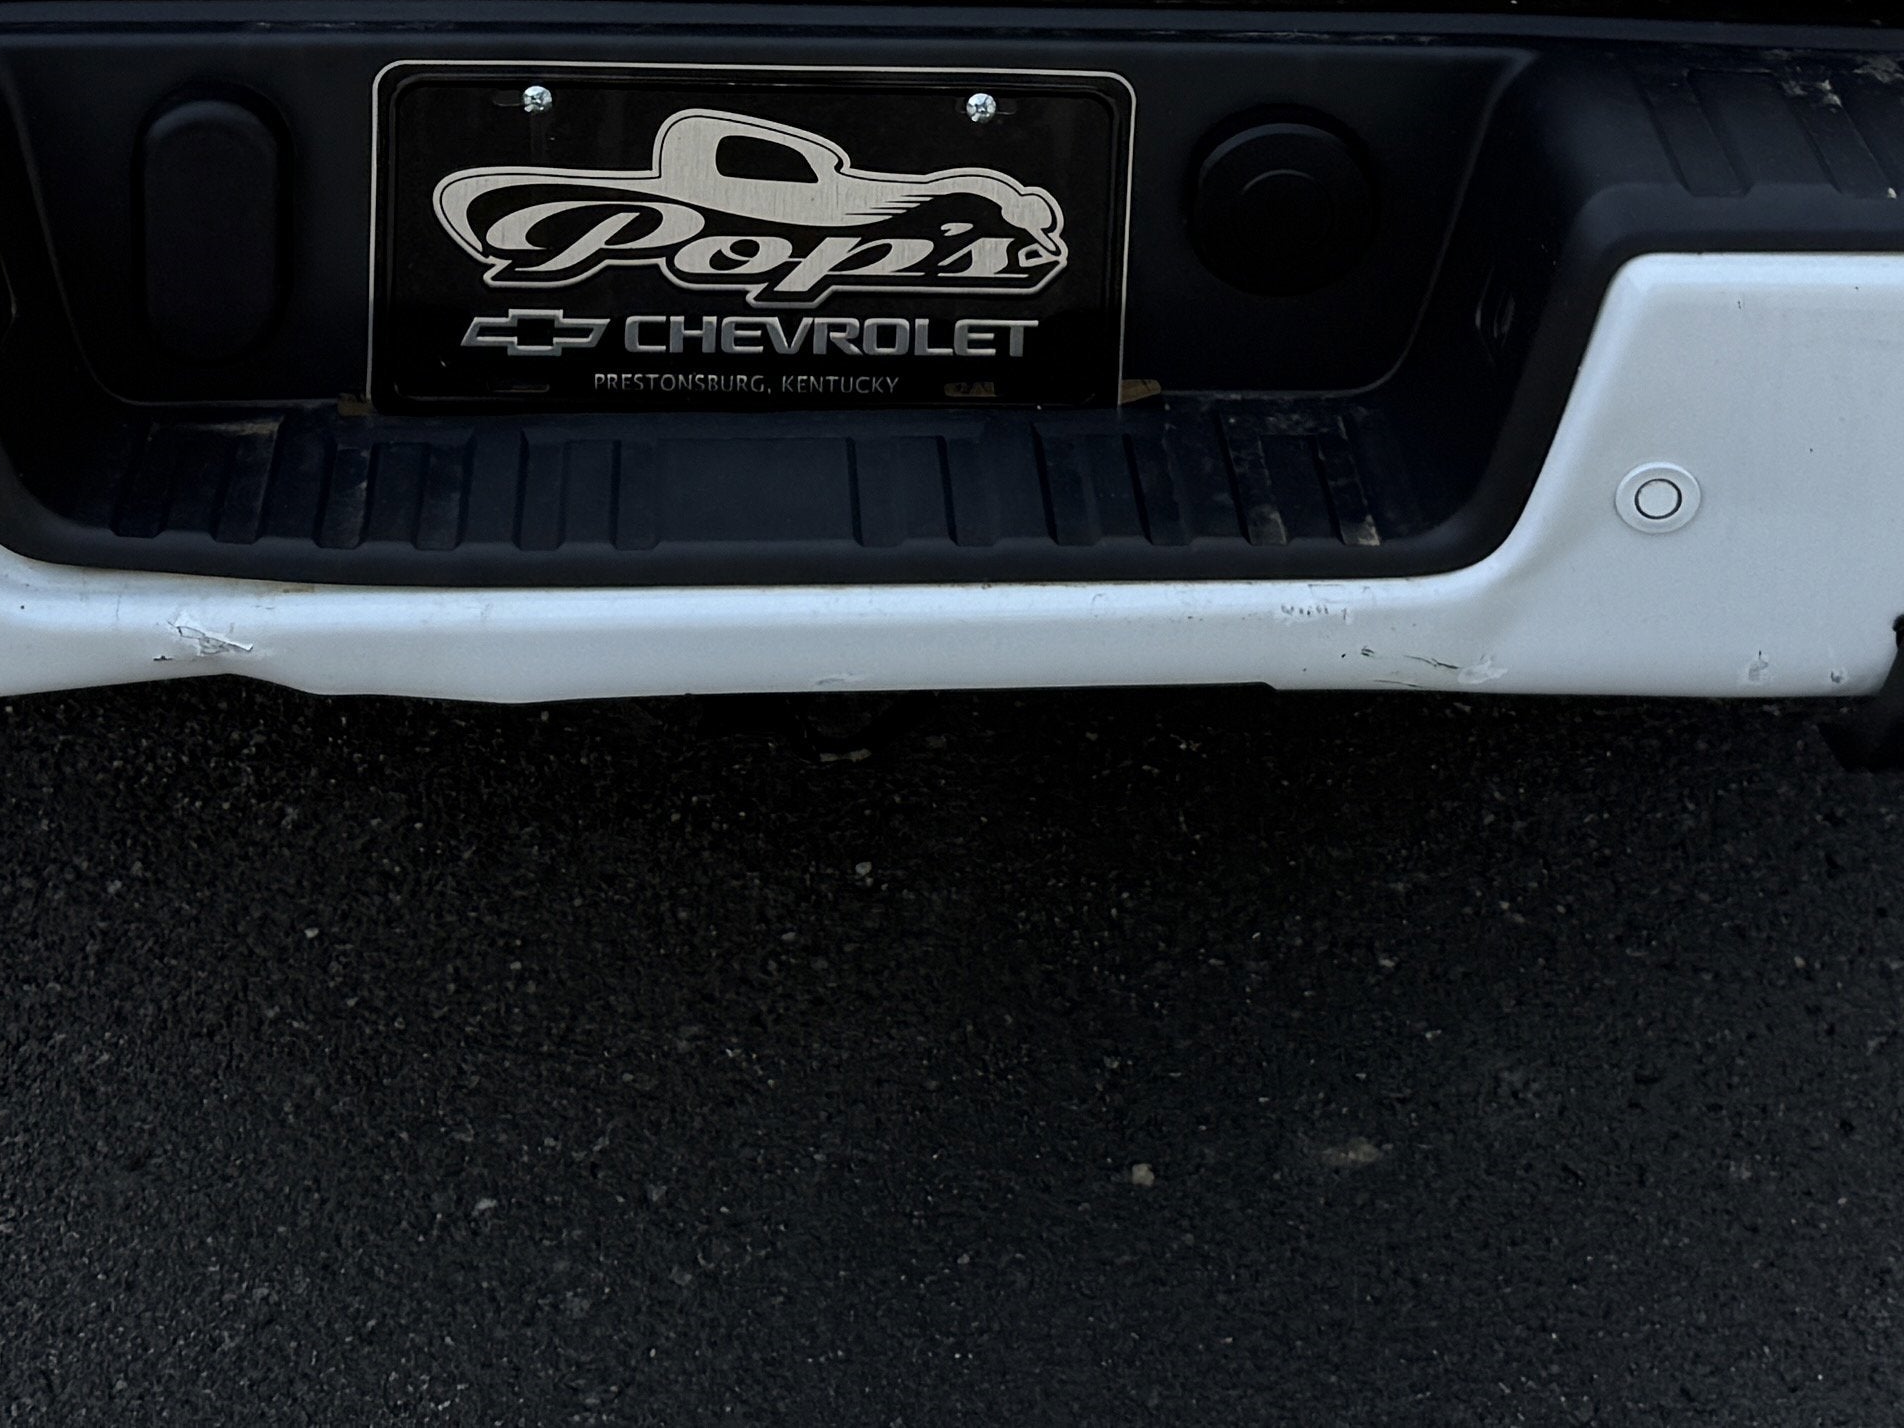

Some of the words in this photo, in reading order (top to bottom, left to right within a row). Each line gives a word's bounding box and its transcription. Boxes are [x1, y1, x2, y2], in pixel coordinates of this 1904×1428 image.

[486, 200, 1029, 293] Pop's
[623, 315, 1039, 358] CHEVROLET
[594, 372, 771, 396] PRESTONSBURG,
[782, 374, 900, 395] KENTUCKY
